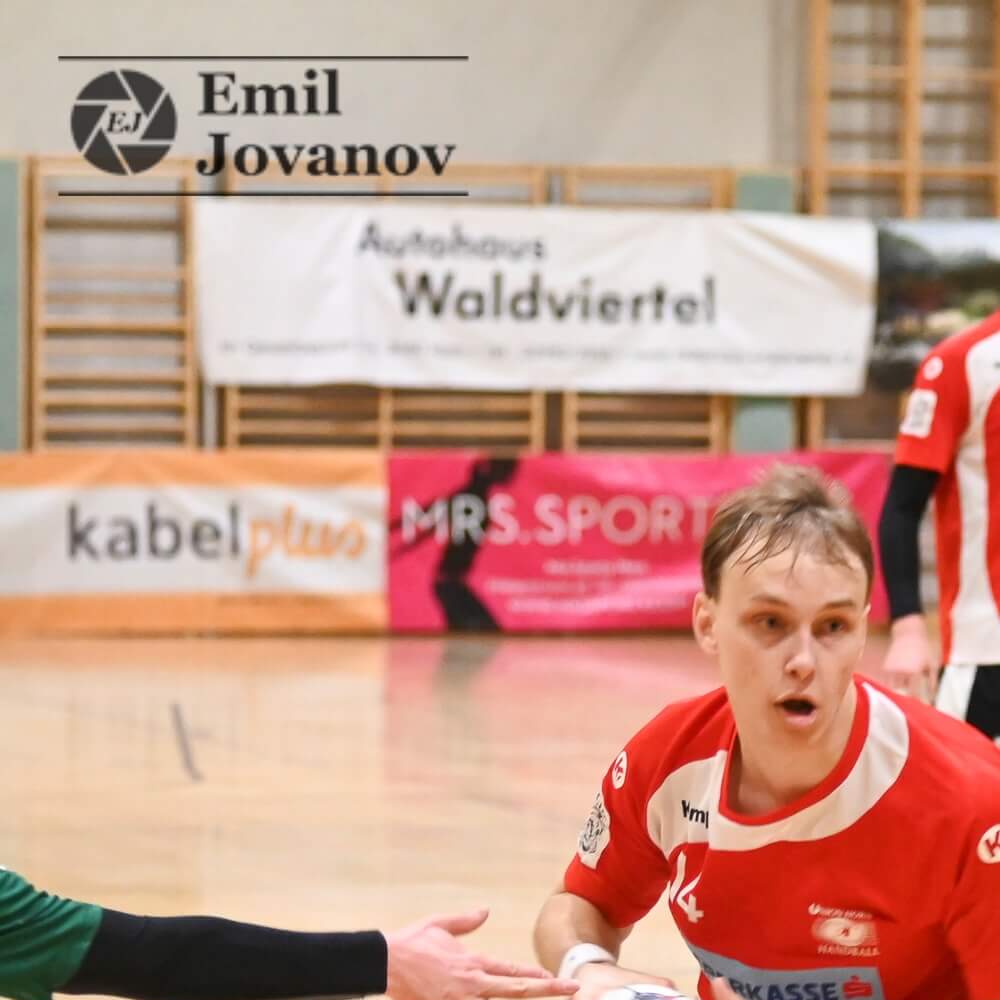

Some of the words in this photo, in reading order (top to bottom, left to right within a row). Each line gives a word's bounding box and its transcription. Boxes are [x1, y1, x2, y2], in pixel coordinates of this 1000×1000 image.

[358, 223, 546, 259] Autohaus
[394, 272, 716, 326] Waldviertel
[67, 503, 368, 579] kabelplus
